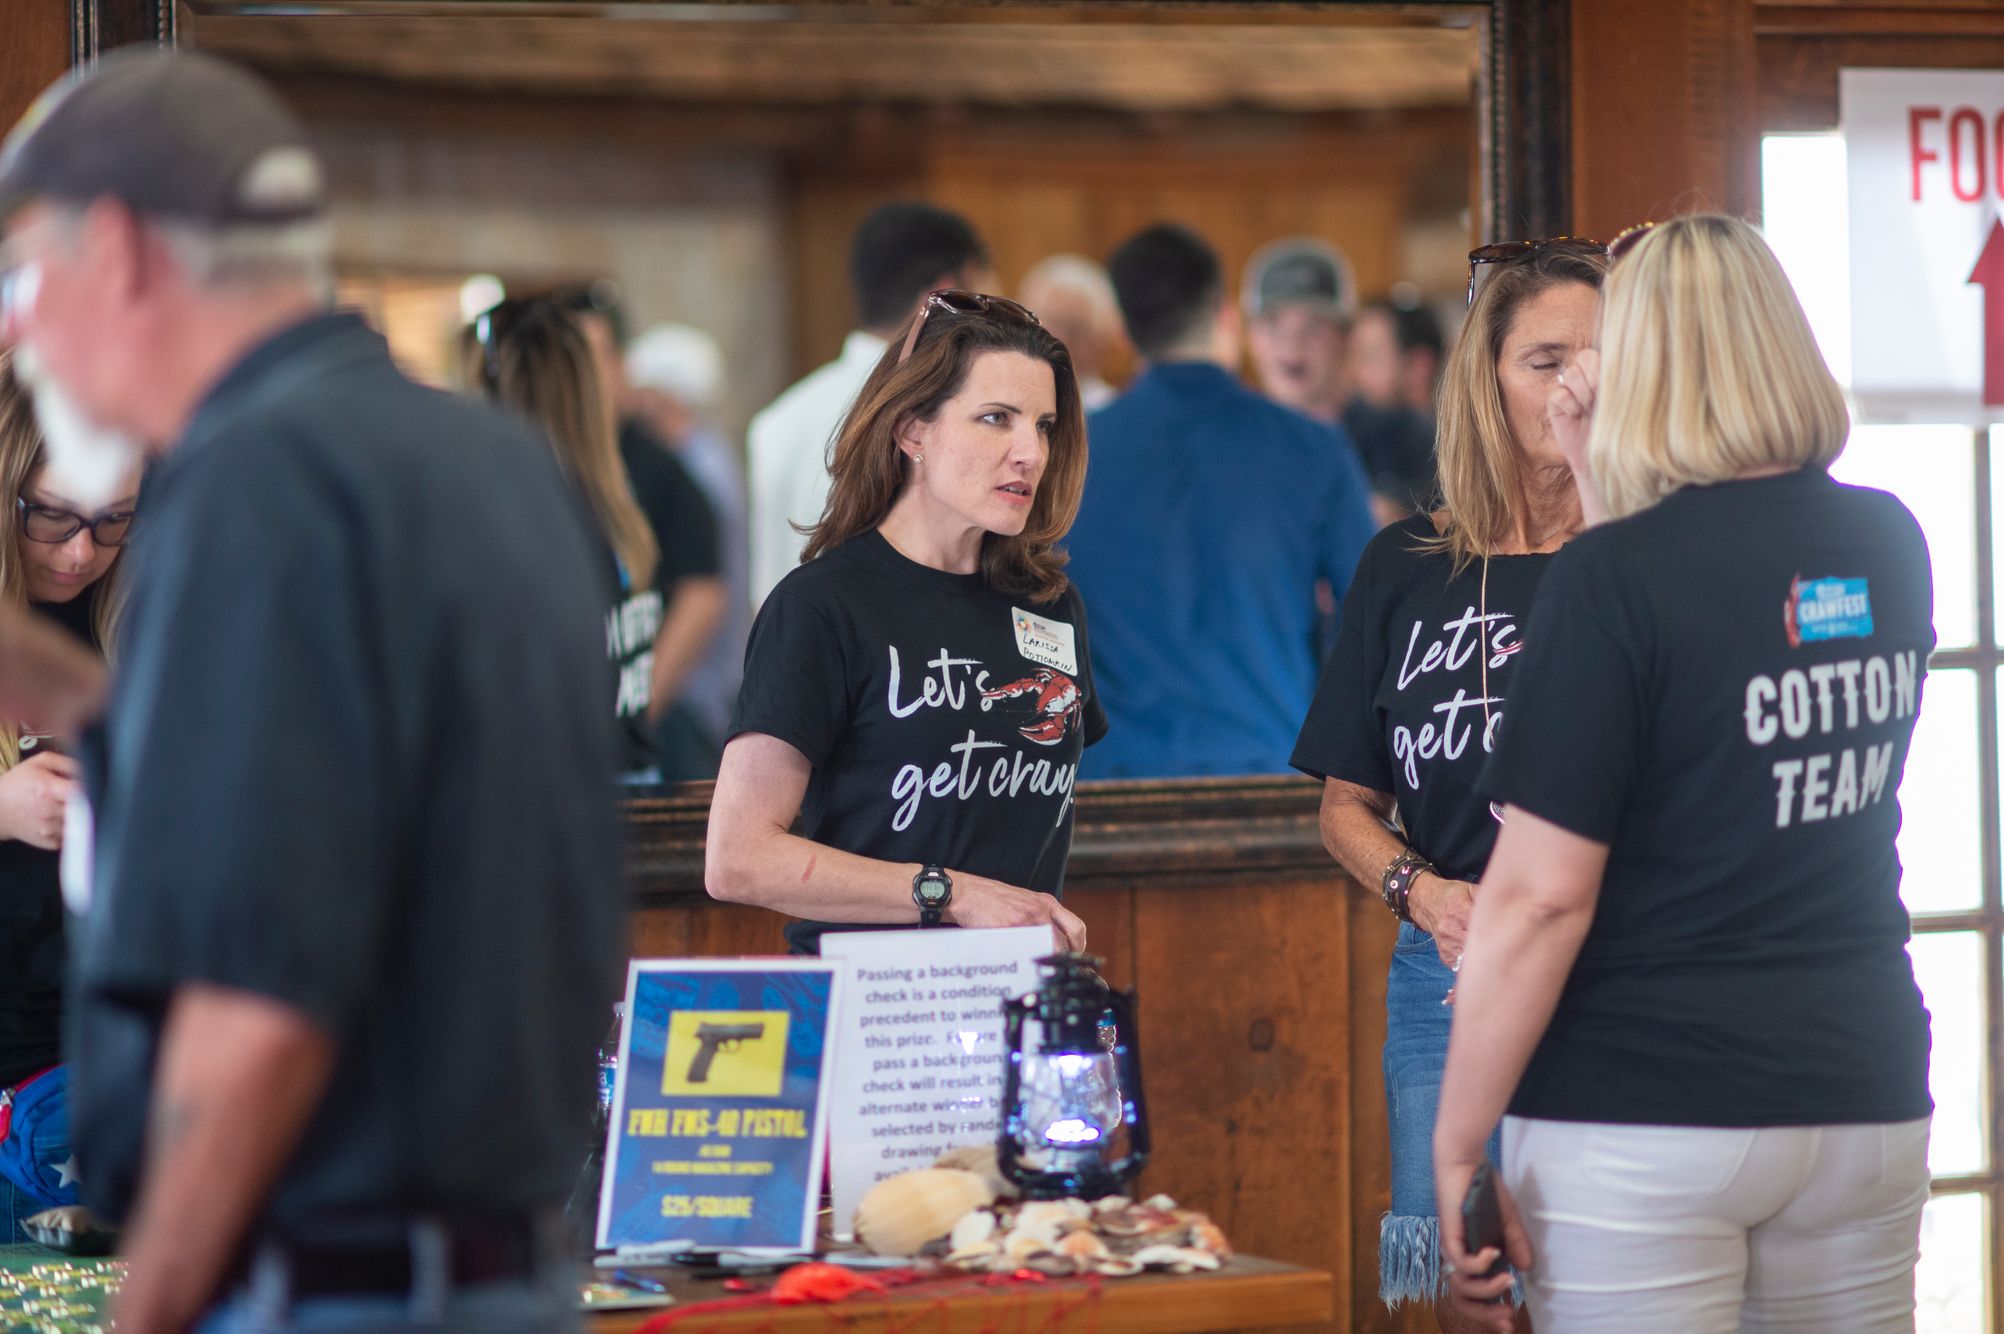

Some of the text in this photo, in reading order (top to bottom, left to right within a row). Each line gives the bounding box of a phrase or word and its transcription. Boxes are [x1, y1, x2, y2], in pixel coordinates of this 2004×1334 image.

[1908, 106, 2004, 203] FO
[1397, 606, 1517, 690] Let's
[888, 645, 996, 718] Let's
[1743, 650, 1917, 745] COTTON
[1394, 689, 1505, 790] get
[891, 729, 1008, 831] get
[1772, 742, 1894, 828] TEAM
[857, 961, 1018, 981] Passing a background
[865, 985, 1012, 1003] check is a condition
[860, 1010, 935, 1027] precedent
[941, 1010, 956, 1021] to
[865, 1034, 892, 1048] this
[873, 1052, 1004, 1073] pass a backgroun
[863, 1078, 904, 1093] check
[910, 1076, 935, 1091] will
[941, 1075, 982, 1088] result
[859, 1099, 927, 1116] alternate
[741, 1109, 807, 1138] PISTOL
[872, 1122, 933, 1138] selected
[938, 1120, 956, 1135] by
[881, 1143, 942, 1159] drawing
